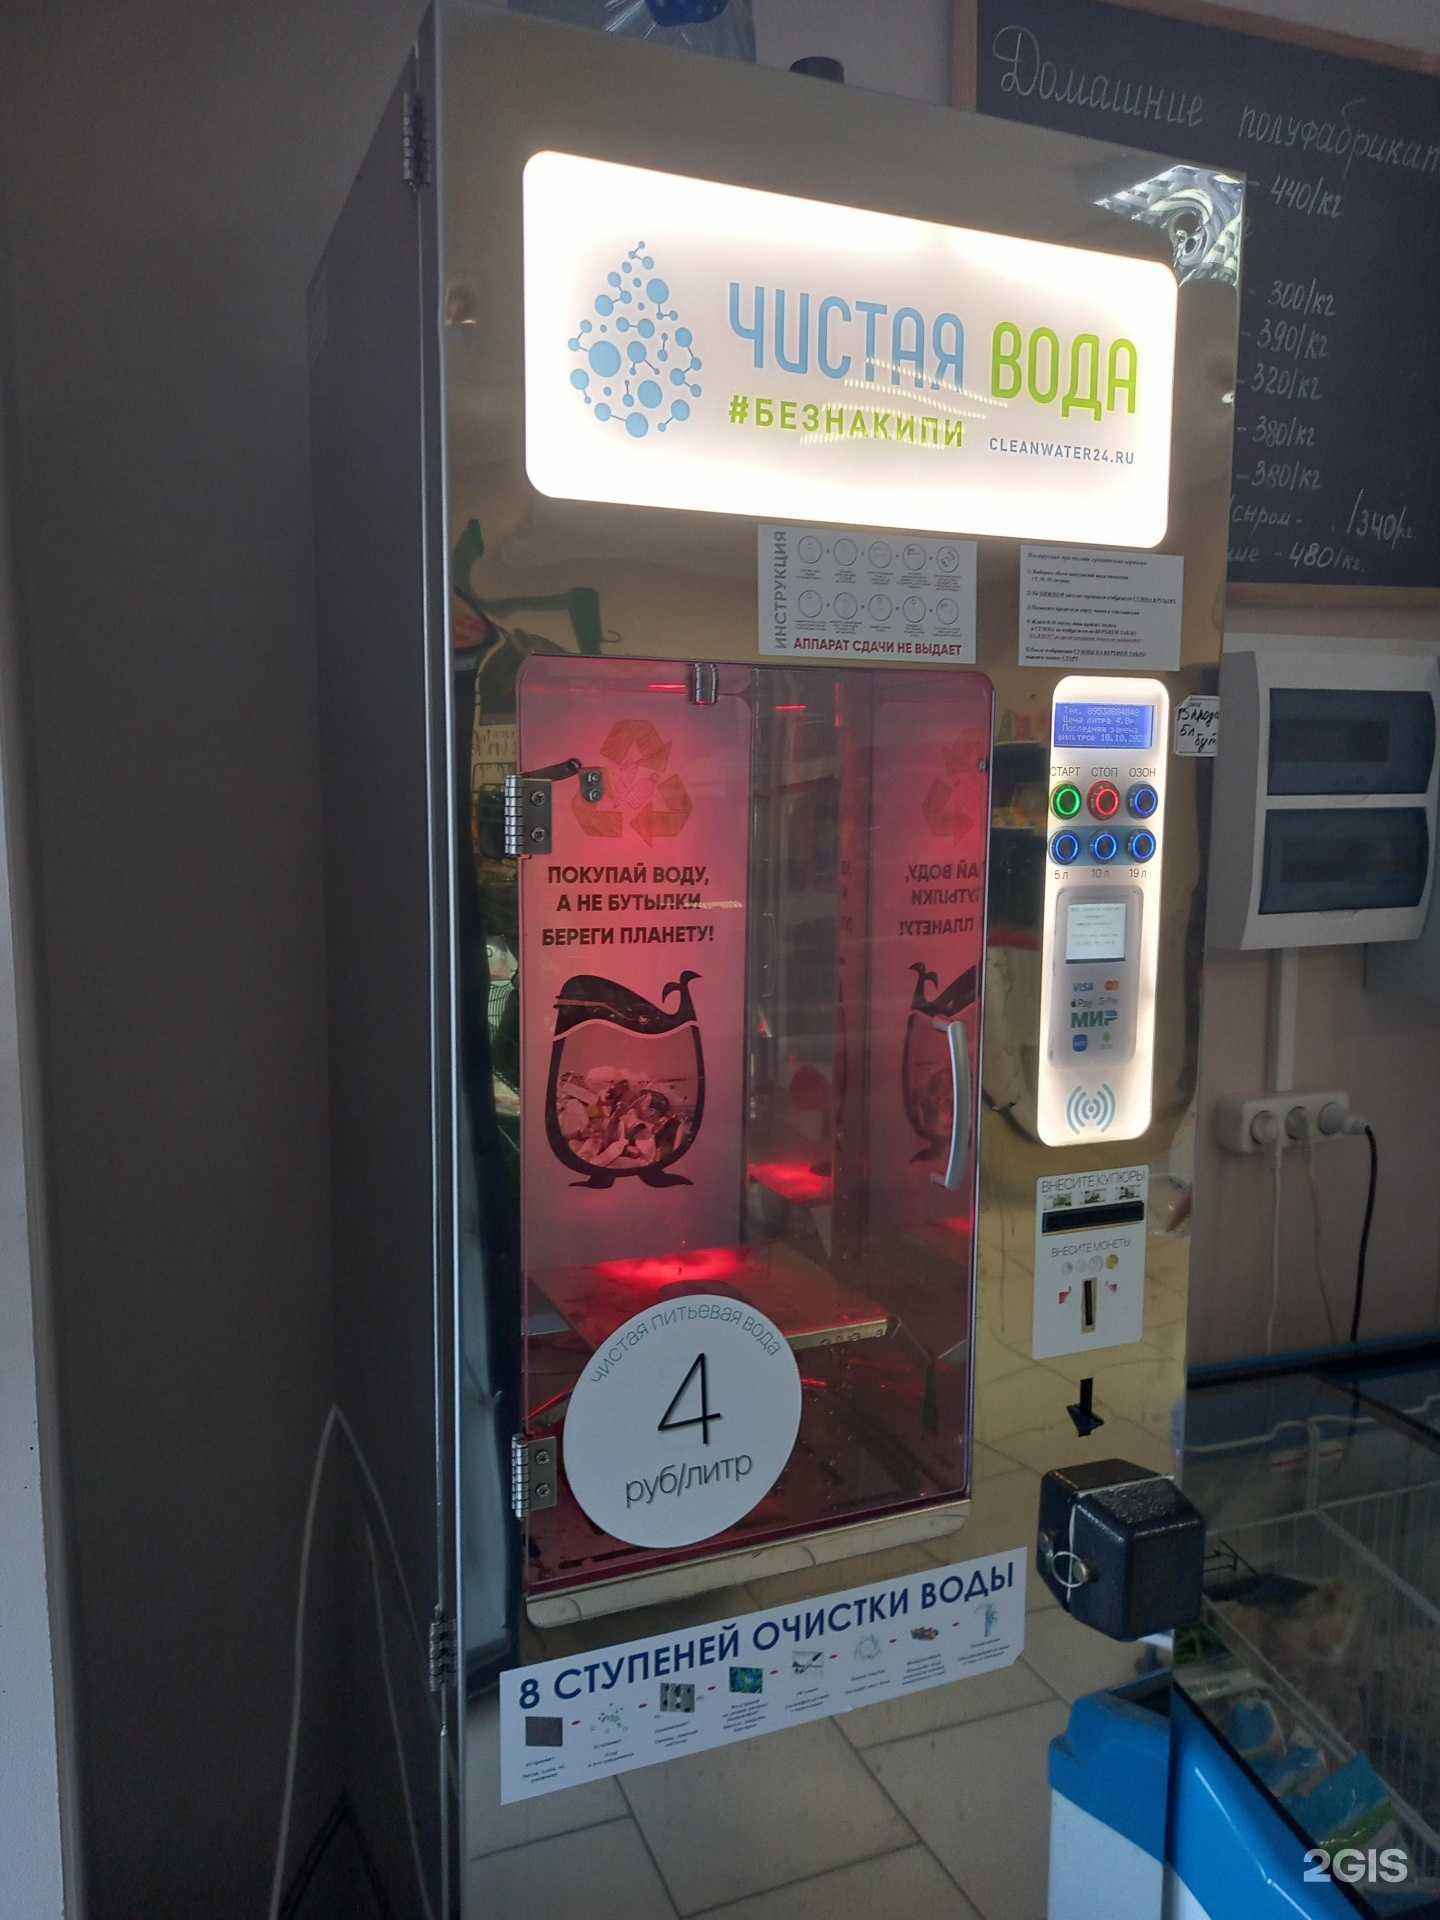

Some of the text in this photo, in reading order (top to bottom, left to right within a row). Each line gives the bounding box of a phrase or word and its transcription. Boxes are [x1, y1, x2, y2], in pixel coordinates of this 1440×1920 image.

[993, 26, 1205, 128] Домашние
[728, 282, 1138, 422] ЧИСТАЯ ВОДА
[727, 395, 965, 449] #БЕЗНАКИПИ
[988, 438, 1136, 466] CLEANWATER24.RU
[774, 531, 788, 649] ИНСТРУКЦИЯ
[793, 637, 963, 657] АППАРАТ СДАЧИ НЕ ВЫДАЕТ
[1050, 766, 1156, 778] СТАРТ СТОП ОЗОН
[547, 861, 710, 886] ПОКУПАЙ ВОДУ,
[555, 893, 703, 912] А НЕ БУТЫЛКИ
[541, 925, 715, 946] БЕРЕГИ ПЛАНЕТУ!
[1071, 1009, 1119, 1029] МИР
[591, 1303, 782, 1383] чистая питьевая вода
[657, 1352, 723, 1446] 4
[625, 1454, 754, 1509] руб/литр
[518, 1677, 541, 1710] 8
[552, 1624, 741, 1701] СТУПЕНЕЙ
[752, 1587, 909, 1651] ОЧИСТКИ
[920, 1562, 1015, 1611] ВОДЫ
